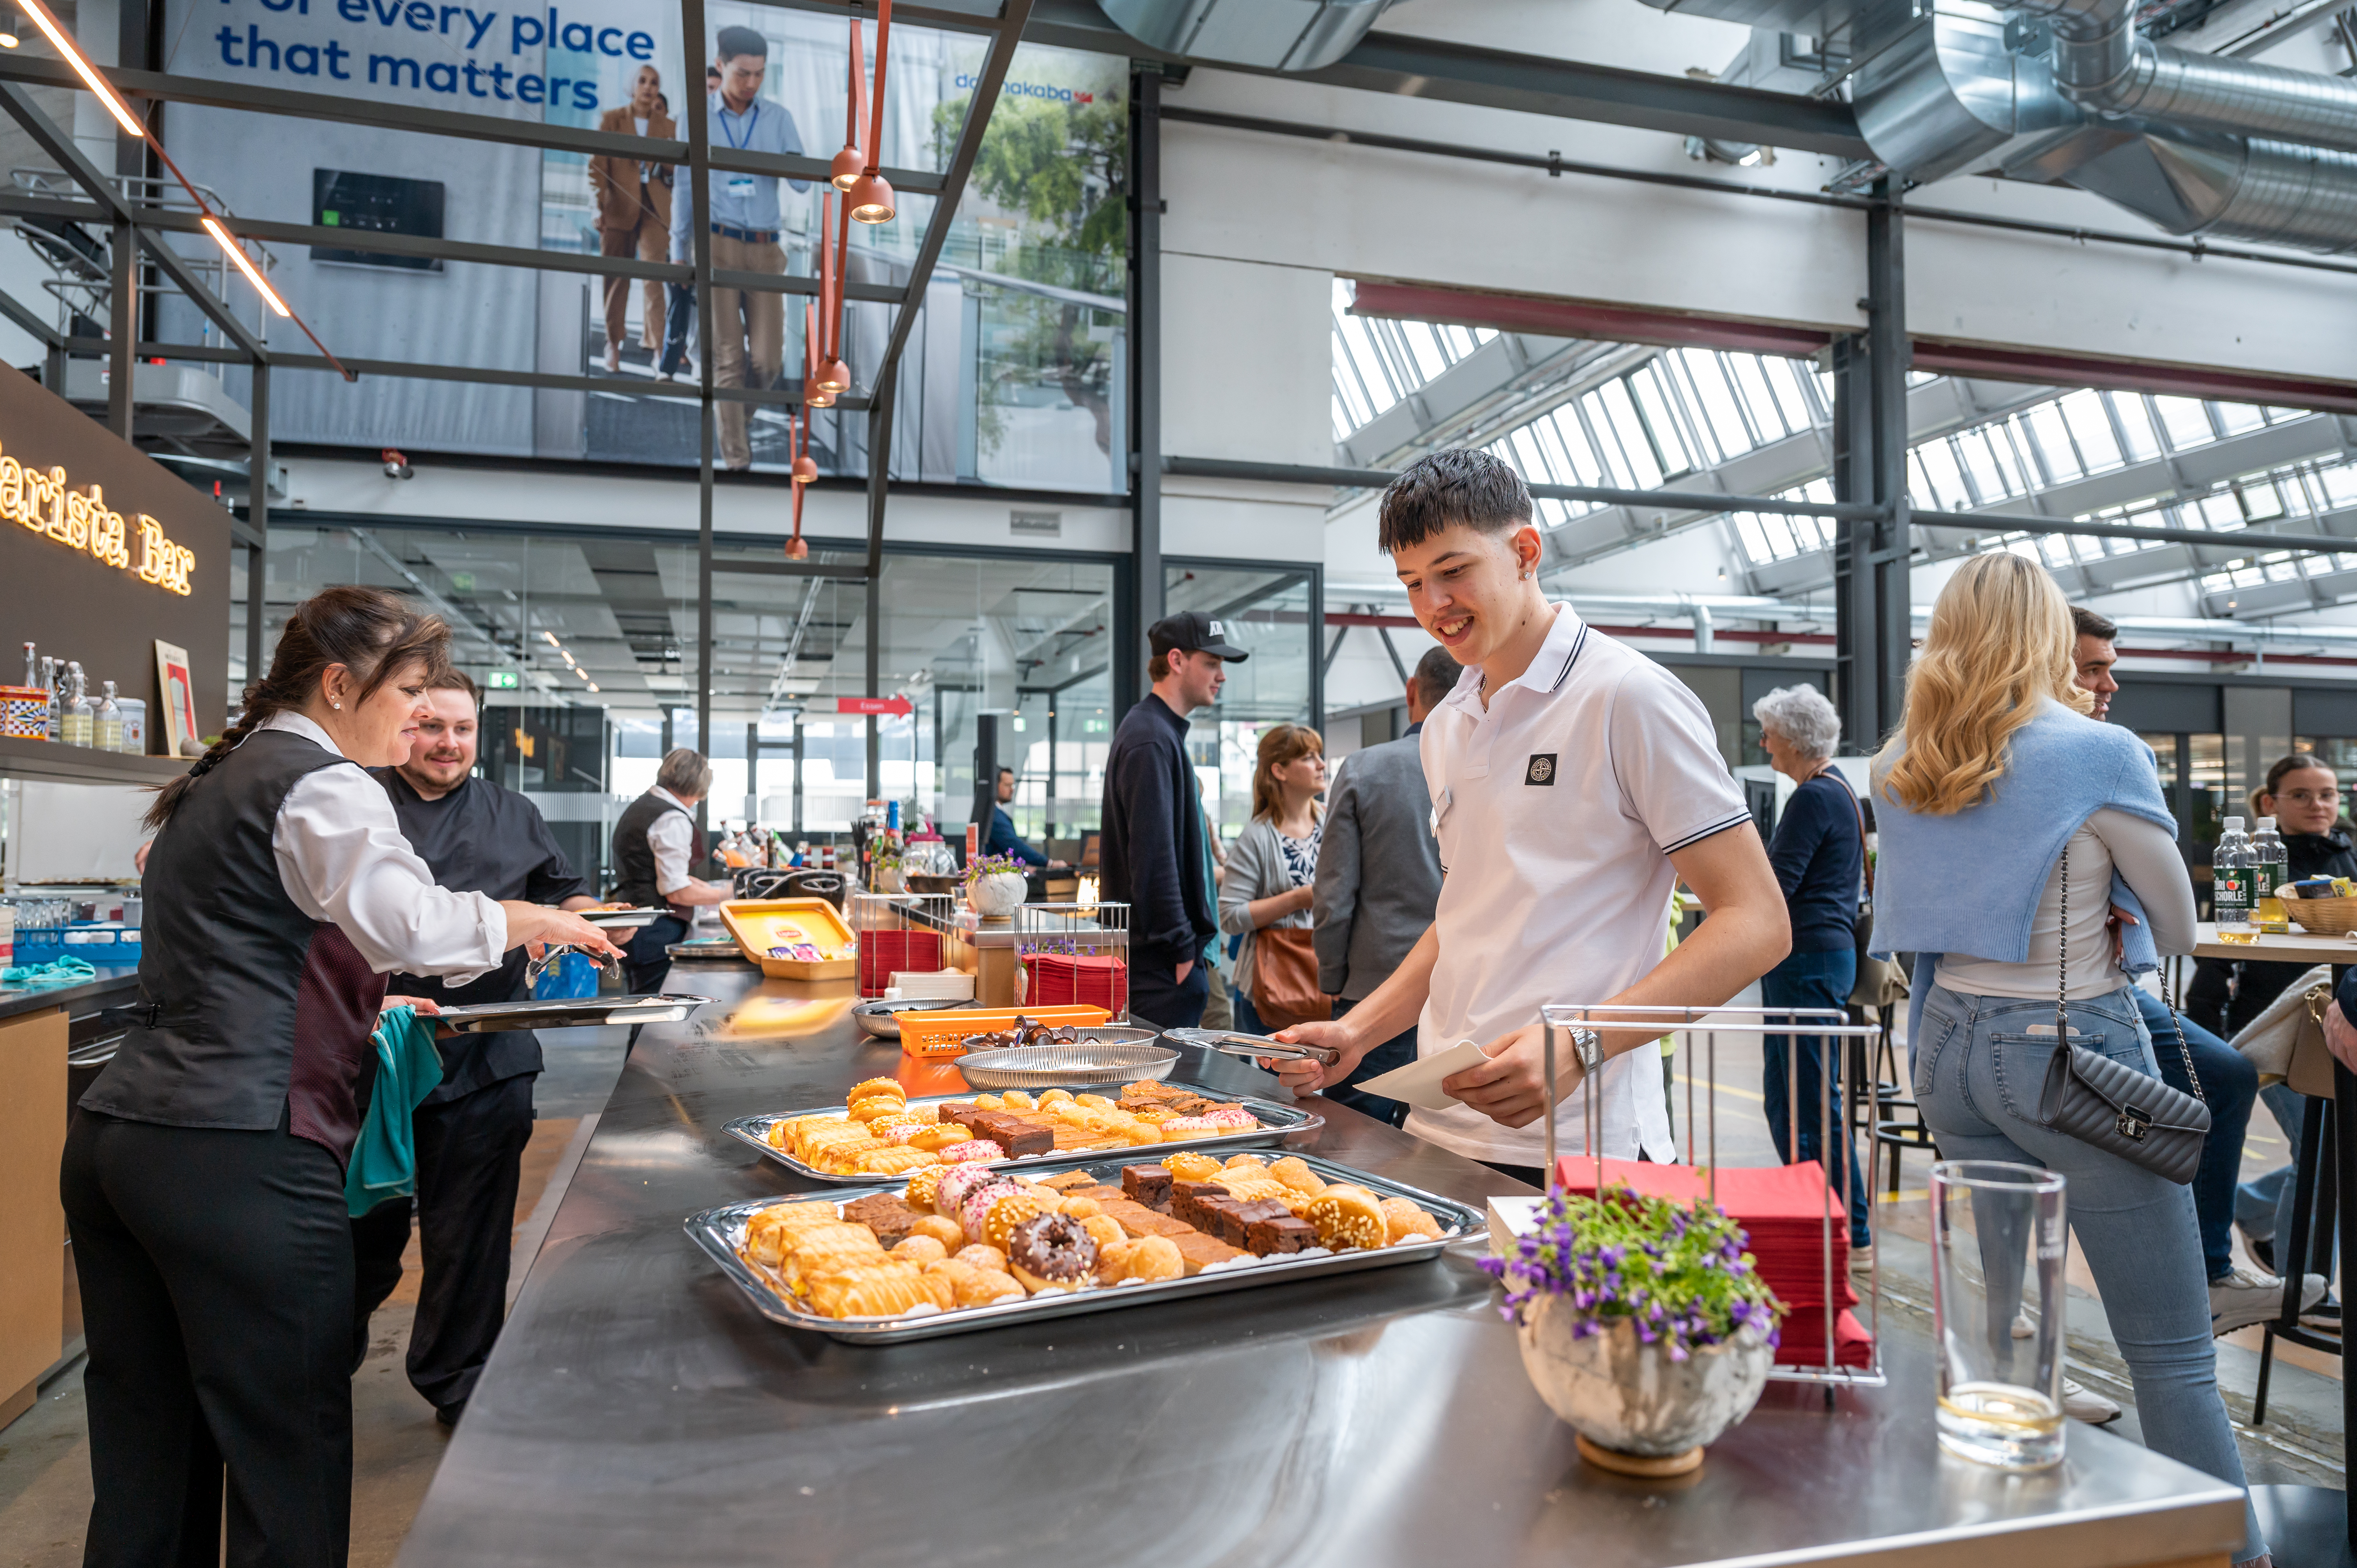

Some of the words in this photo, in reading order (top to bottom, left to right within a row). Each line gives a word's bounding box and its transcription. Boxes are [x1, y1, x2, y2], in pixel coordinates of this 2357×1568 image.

[214, 23, 351, 80] that
[368, 53, 599, 111] matters
[337, 0, 497, 49] every
[511, 7, 654, 60] place
[0, 455, 130, 569] arista
[138, 514, 195, 596] Bar
[1533, 760, 1541, 769] STONE
